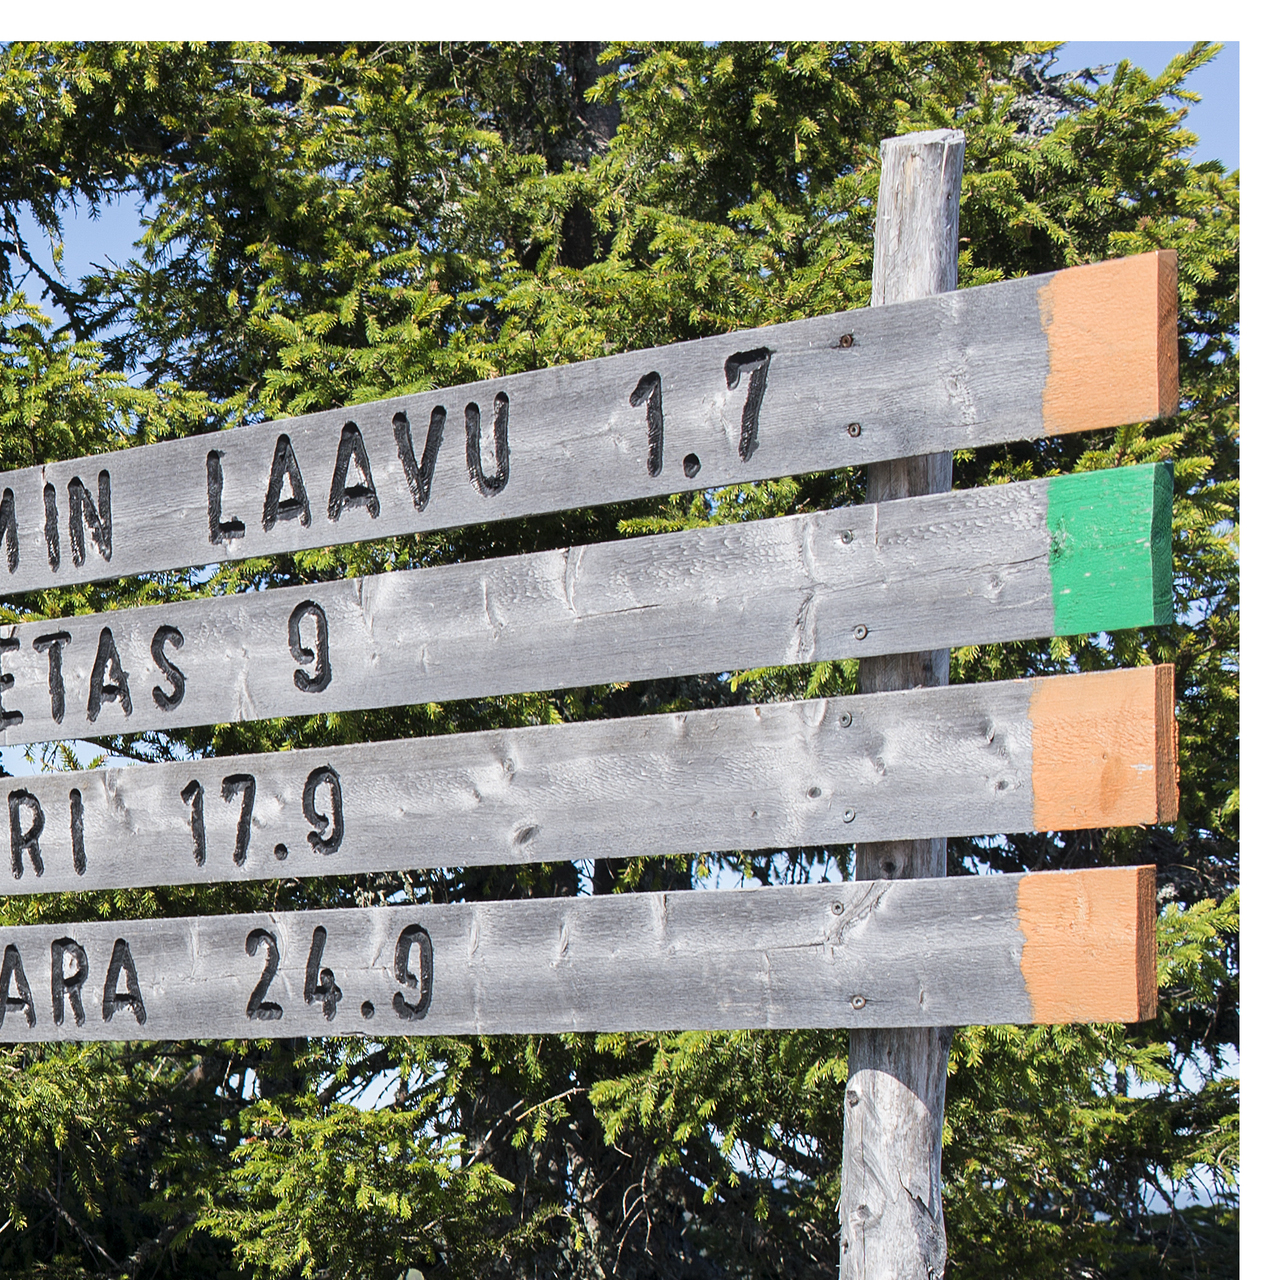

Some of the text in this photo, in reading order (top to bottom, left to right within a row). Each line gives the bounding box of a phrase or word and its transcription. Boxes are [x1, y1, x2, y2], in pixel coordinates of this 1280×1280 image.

[206, 391, 510, 545] LAAVU
[628, 346, 773, 479] 1.7
[287, 600, 332, 694] 9
[180, 763, 345, 868] 17.9
[244, 922, 435, 1022] 24.9
